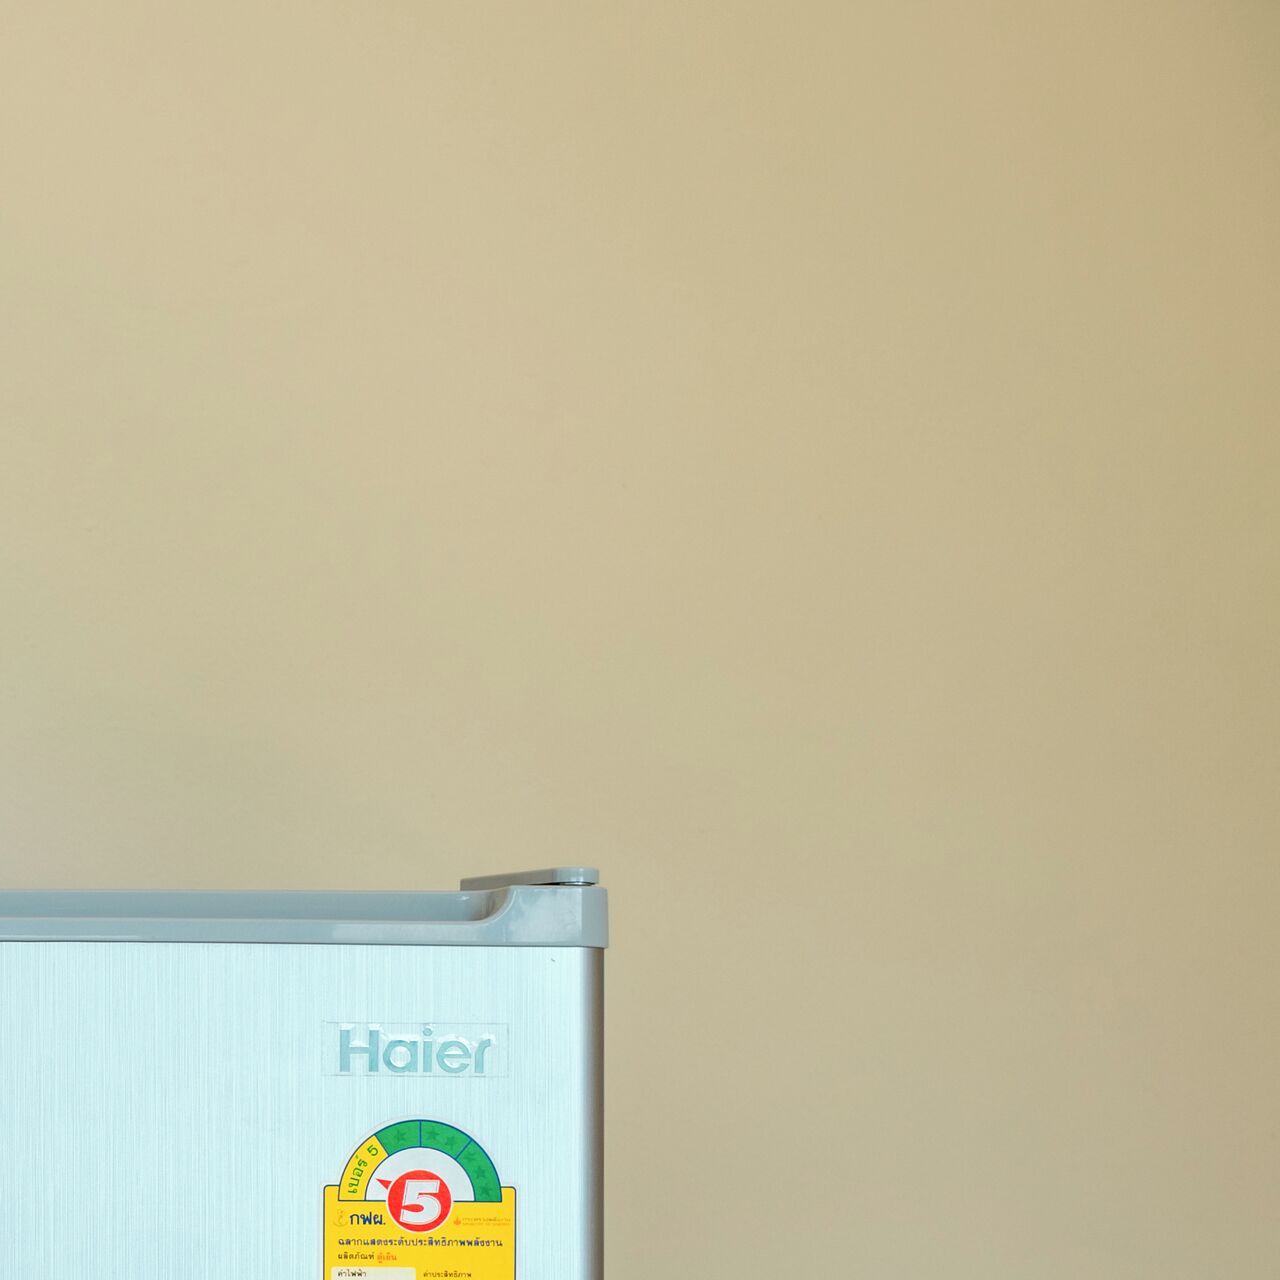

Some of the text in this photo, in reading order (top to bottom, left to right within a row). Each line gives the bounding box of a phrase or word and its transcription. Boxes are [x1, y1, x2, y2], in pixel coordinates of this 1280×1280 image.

[339, 1027, 492, 1074] Haier
[348, 1145, 378, 1193] เบอร์ 5
[350, 1212, 386, 1225] กฟผ.
[400, 1180, 442, 1225] 5
